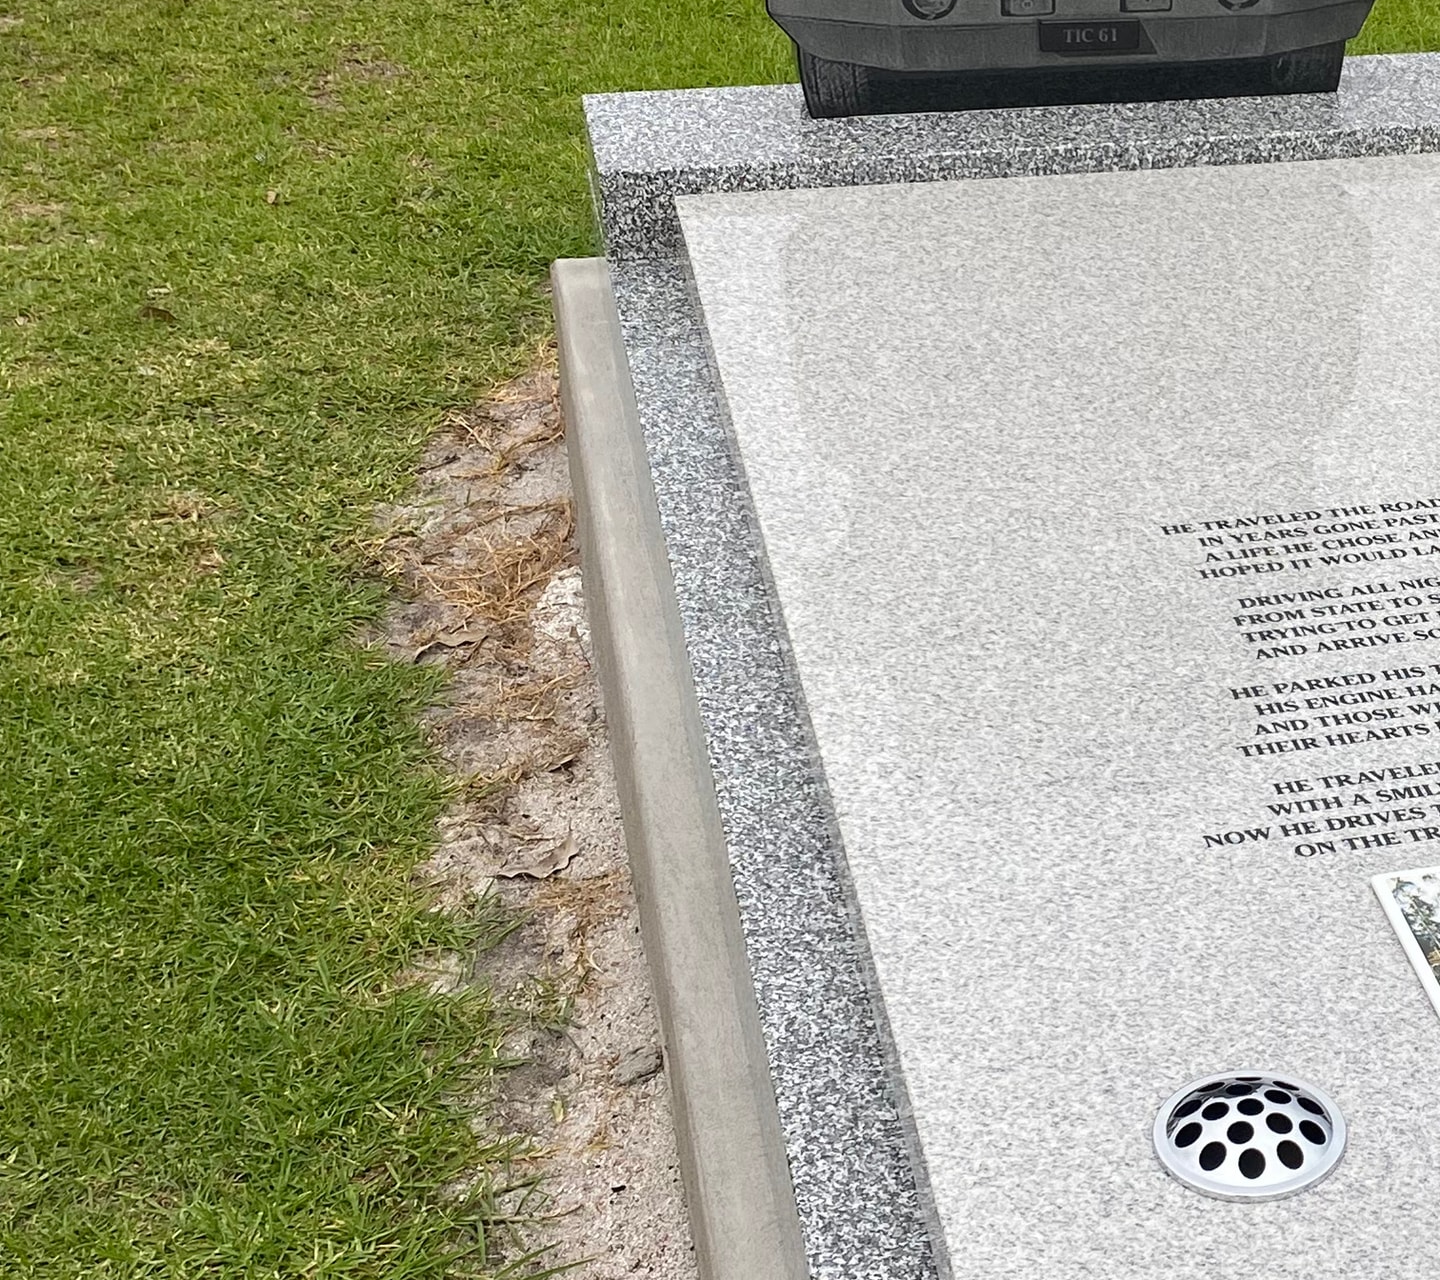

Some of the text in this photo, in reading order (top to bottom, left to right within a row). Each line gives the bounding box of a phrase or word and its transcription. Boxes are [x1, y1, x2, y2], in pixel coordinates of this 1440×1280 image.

[1063, 28, 1093, 43] TIC
[1161, 523, 1196, 536] HE
[1201, 510, 1321, 532] TRAVELED
[1326, 504, 1376, 519] THE
[1198, 513, 1440, 547] IN YEARS GONE PAST
[1205, 552, 1222, 563] A
[1227, 546, 1279, 560] LIFE
[1283, 541, 1318, 554] HE
[1322, 532, 1402, 550] CHOSE
[1200, 561, 1284, 579] HOPED
[1290, 558, 1312, 570] IT
[1319, 548, 1408, 566] WOULD
[1234, 609, 1306, 626] FROM
[1311, 600, 1385, 618] STATE
[1389, 595, 1422, 608] TO
[1238, 588, 1343, 608] DRIVING
[1350, 583, 1395, 596] ALL
[1241, 623, 1338, 642] TRYING
[1338, 618, 1377, 631] TO
[1384, 612, 1431, 627] GET
[1256, 645, 1307, 660] AND
[1317, 631, 1410, 652] ARRIVE
[1231, 684, 1268, 700] HE
[1274, 673, 1376, 695] PARKED
[1383, 665, 1426, 681] HIS
[1255, 700, 1300, 716] HIS
[1306, 687, 1400, 710] ENGINE
[1255, 719, 1308, 735] AND
[1314, 707, 1404, 728] THOSE
[1237, 736, 1321, 757] THEIR
[1327, 723, 1430, 747] HEARTS
[1273, 779, 1313, 795] HE
[1267, 797, 1344, 816] WITH
[1352, 793, 1372, 806] A
[1203, 827, 1271, 848] NOW
[1280, 822, 1321, 837] HE
[1327, 806, 1426, 831] DRIVES
[1295, 841, 1336, 857] ON
[1341, 832, 1401, 851] THE
